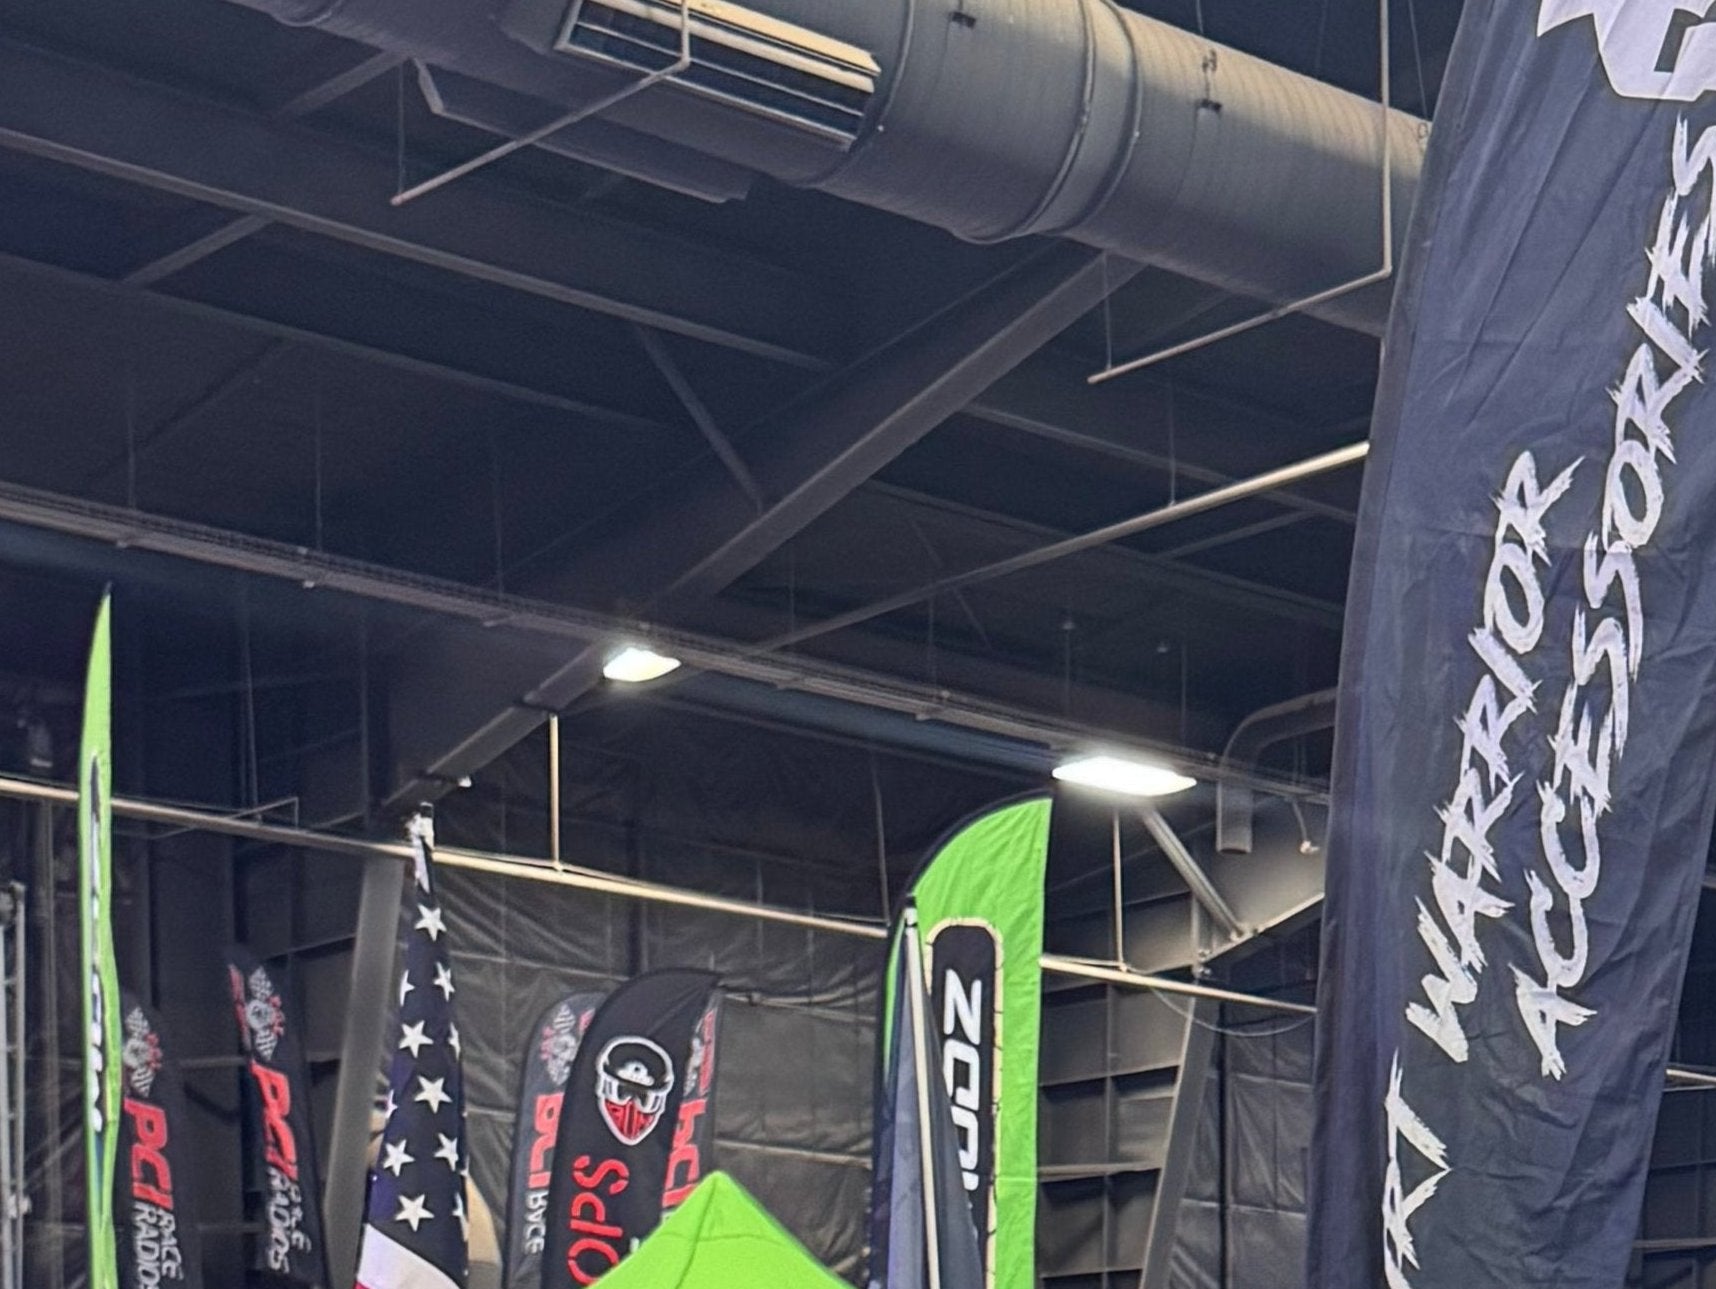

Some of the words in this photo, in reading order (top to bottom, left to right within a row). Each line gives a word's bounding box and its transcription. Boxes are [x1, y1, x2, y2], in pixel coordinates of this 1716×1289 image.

[1404, 449, 1586, 1063] WARRIOR
[124, 1097, 174, 1210] PCI
[251, 1058, 298, 1181] PCI
